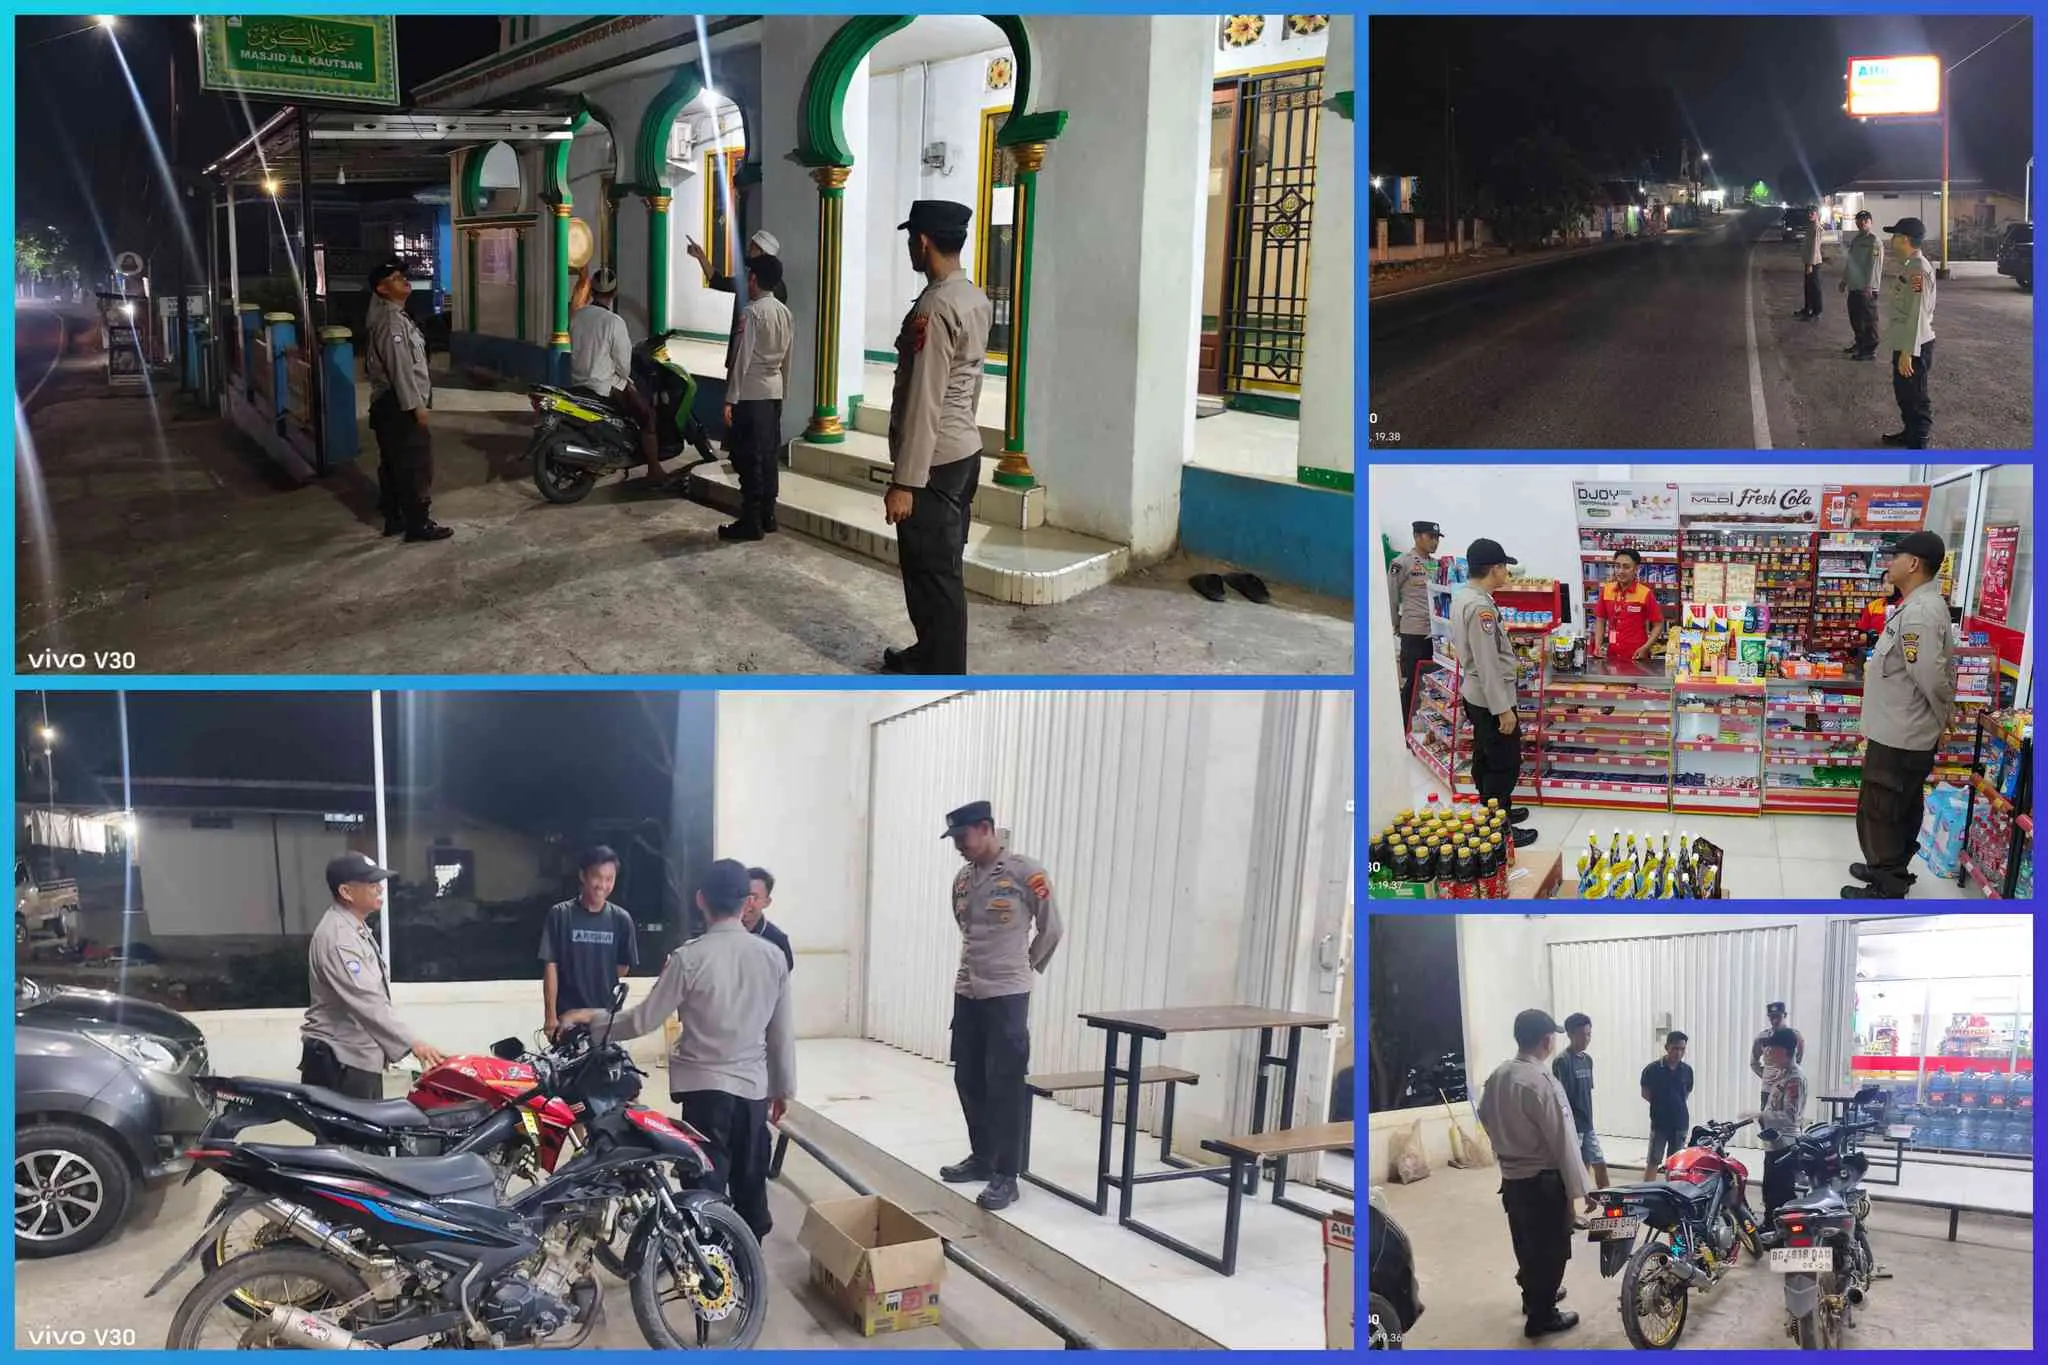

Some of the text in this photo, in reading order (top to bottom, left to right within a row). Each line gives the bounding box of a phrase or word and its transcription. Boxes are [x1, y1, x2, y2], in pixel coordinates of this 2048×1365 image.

[240, 50, 363, 70] MASJID AL KAUTSAR
[1577, 488, 1619, 500] DJOY
[1736, 488, 1777, 507] Fresh
[1780, 488, 1812, 510] Cola
